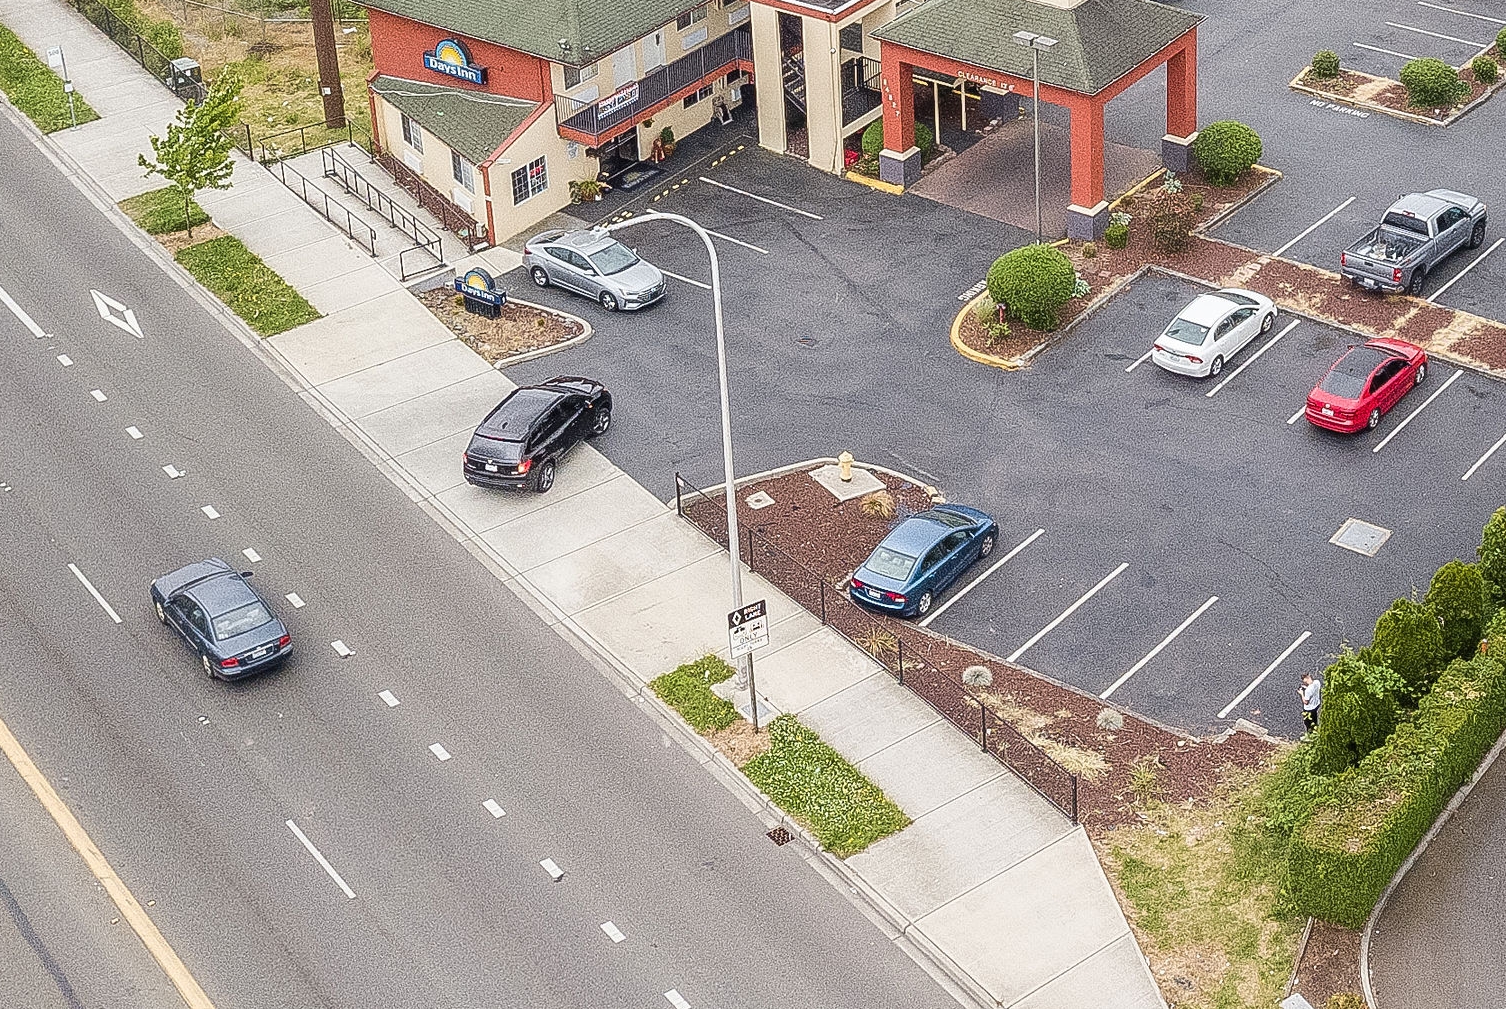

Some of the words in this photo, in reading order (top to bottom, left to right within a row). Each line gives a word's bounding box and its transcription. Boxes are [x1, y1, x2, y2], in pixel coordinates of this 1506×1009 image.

[429, 58, 457, 75] Days
[457, 66, 477, 81] Inn
[958, 71, 997, 87] CLEARANCE
[1309, 99, 1325, 108] NO
[1326, 103, 1370, 119] PARKING
[740, 631, 758, 644] ONLY
